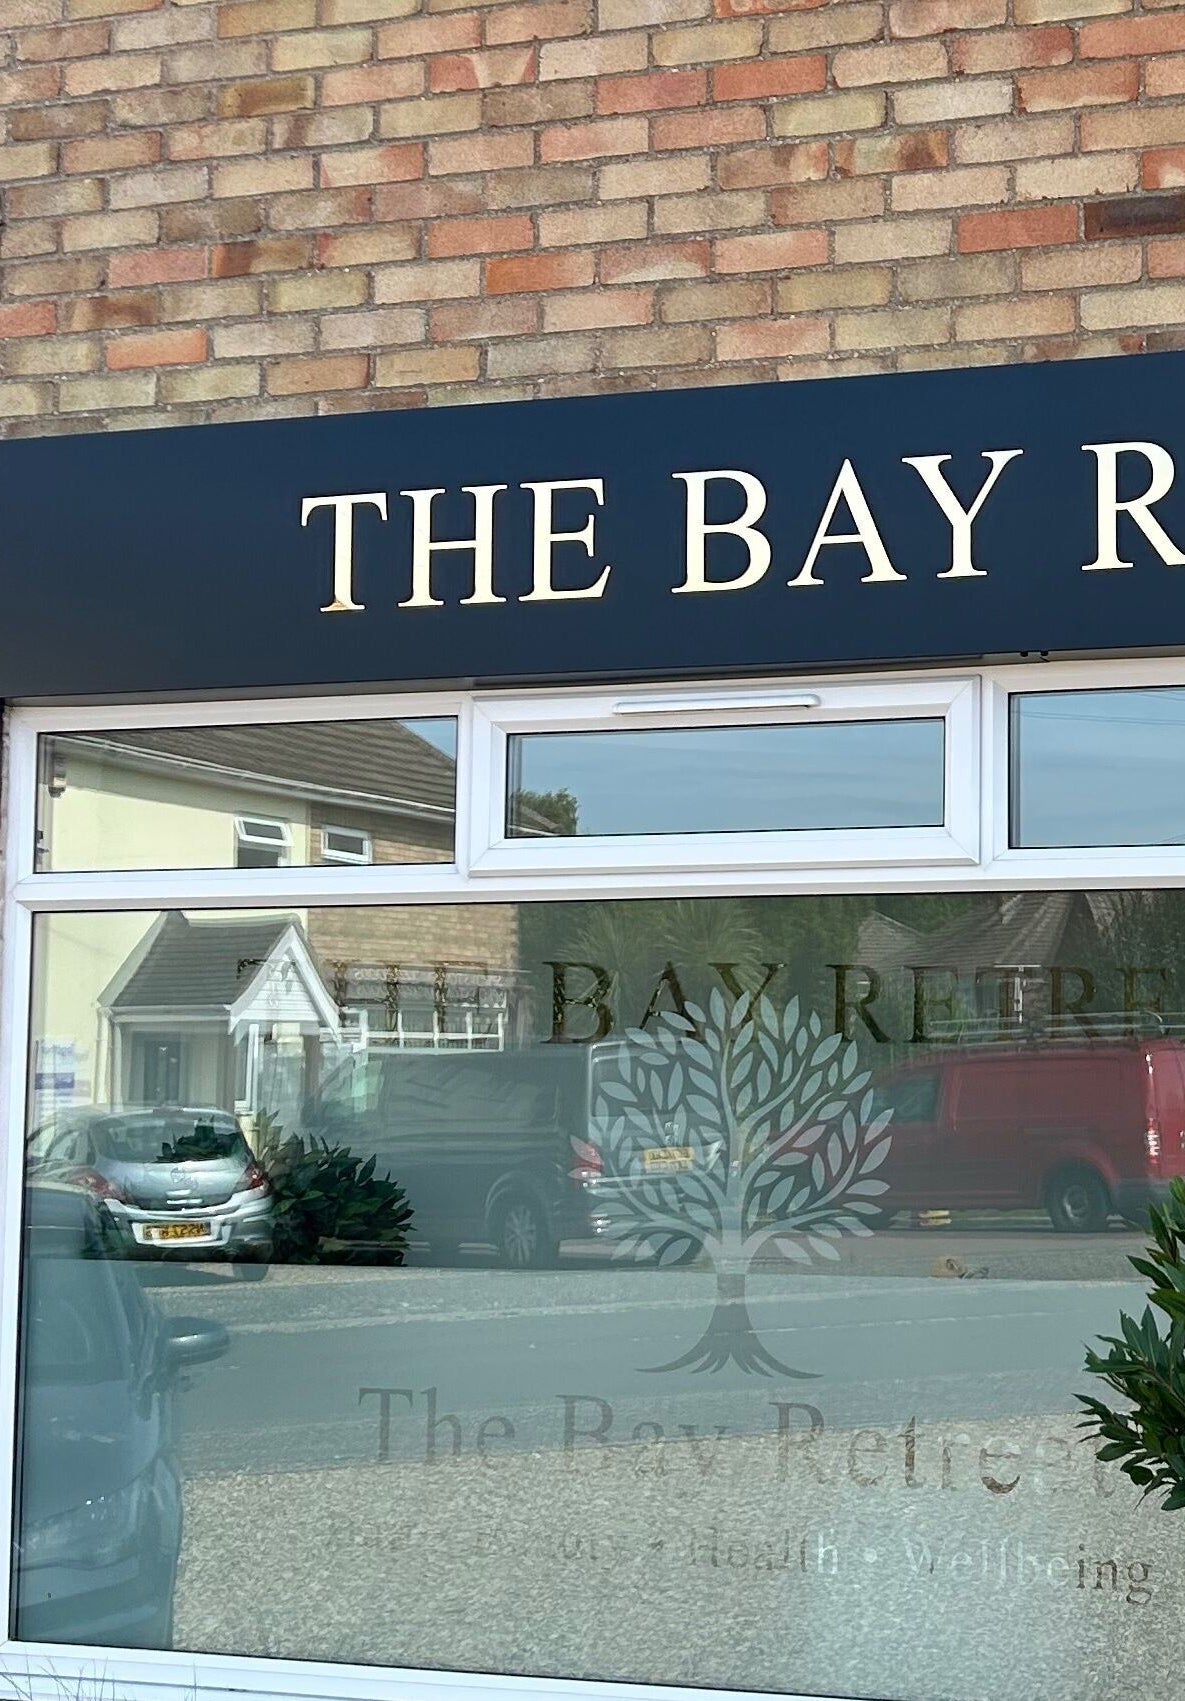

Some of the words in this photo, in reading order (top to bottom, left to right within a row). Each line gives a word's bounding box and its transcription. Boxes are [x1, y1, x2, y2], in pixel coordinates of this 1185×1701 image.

[301, 477, 612, 613] THE
[670, 448, 1024, 595] BAY
[541, 960, 787, 1044] BAY
[358, 1386, 516, 1465] The
[555, 1394, 732, 1490] Bay
